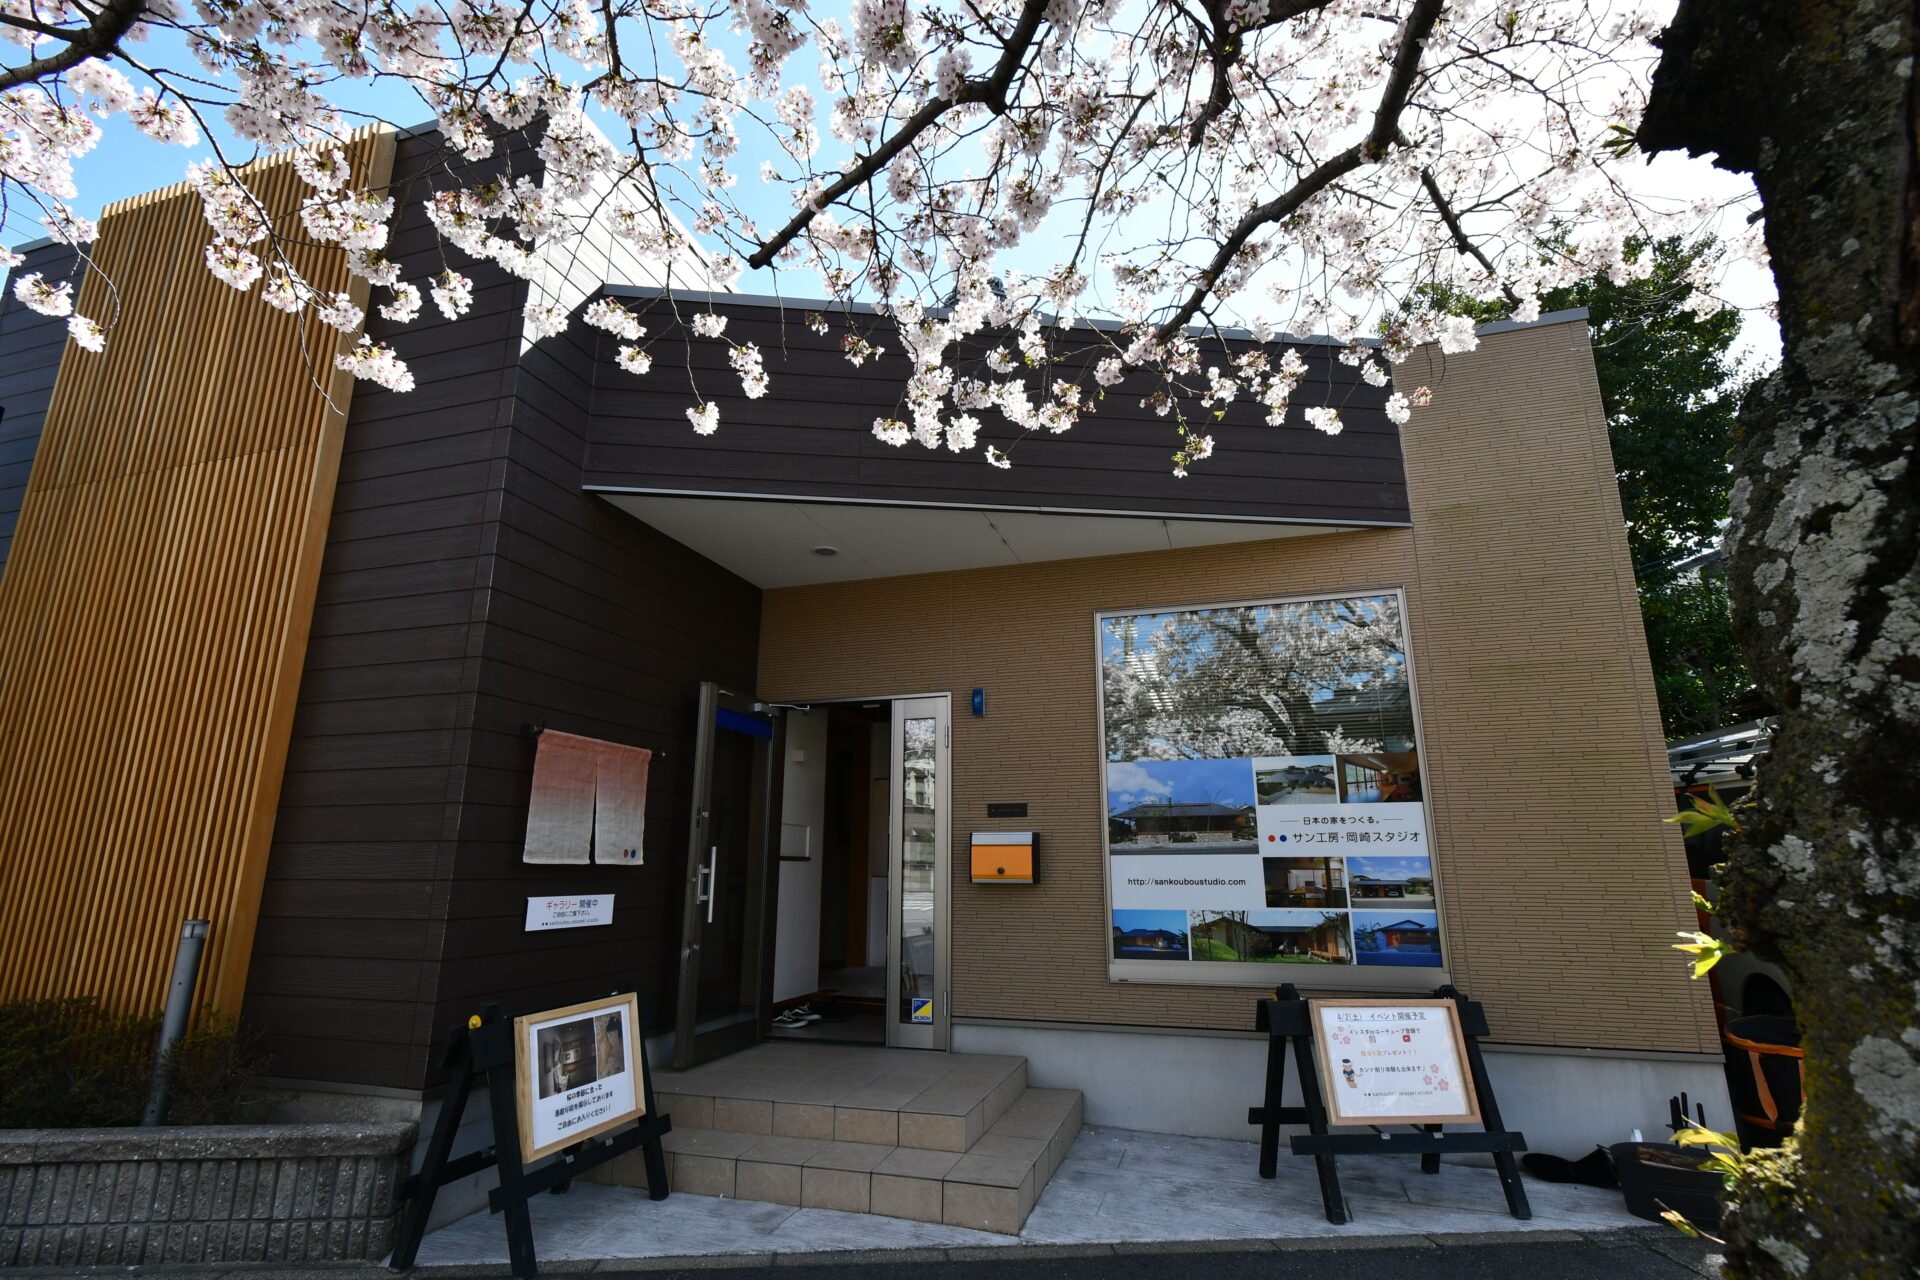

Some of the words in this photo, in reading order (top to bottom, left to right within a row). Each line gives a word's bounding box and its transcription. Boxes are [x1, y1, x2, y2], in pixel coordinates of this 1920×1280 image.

[1303, 816, 1380, 825] 日本の家をつくる。
[1292, 831, 1420, 843] サン工房・岡崎スタジオ
[1127, 878, 1246, 886] http://sankouboustudio.com
[1370, 1011, 1427, 1021] イベント開催予定
